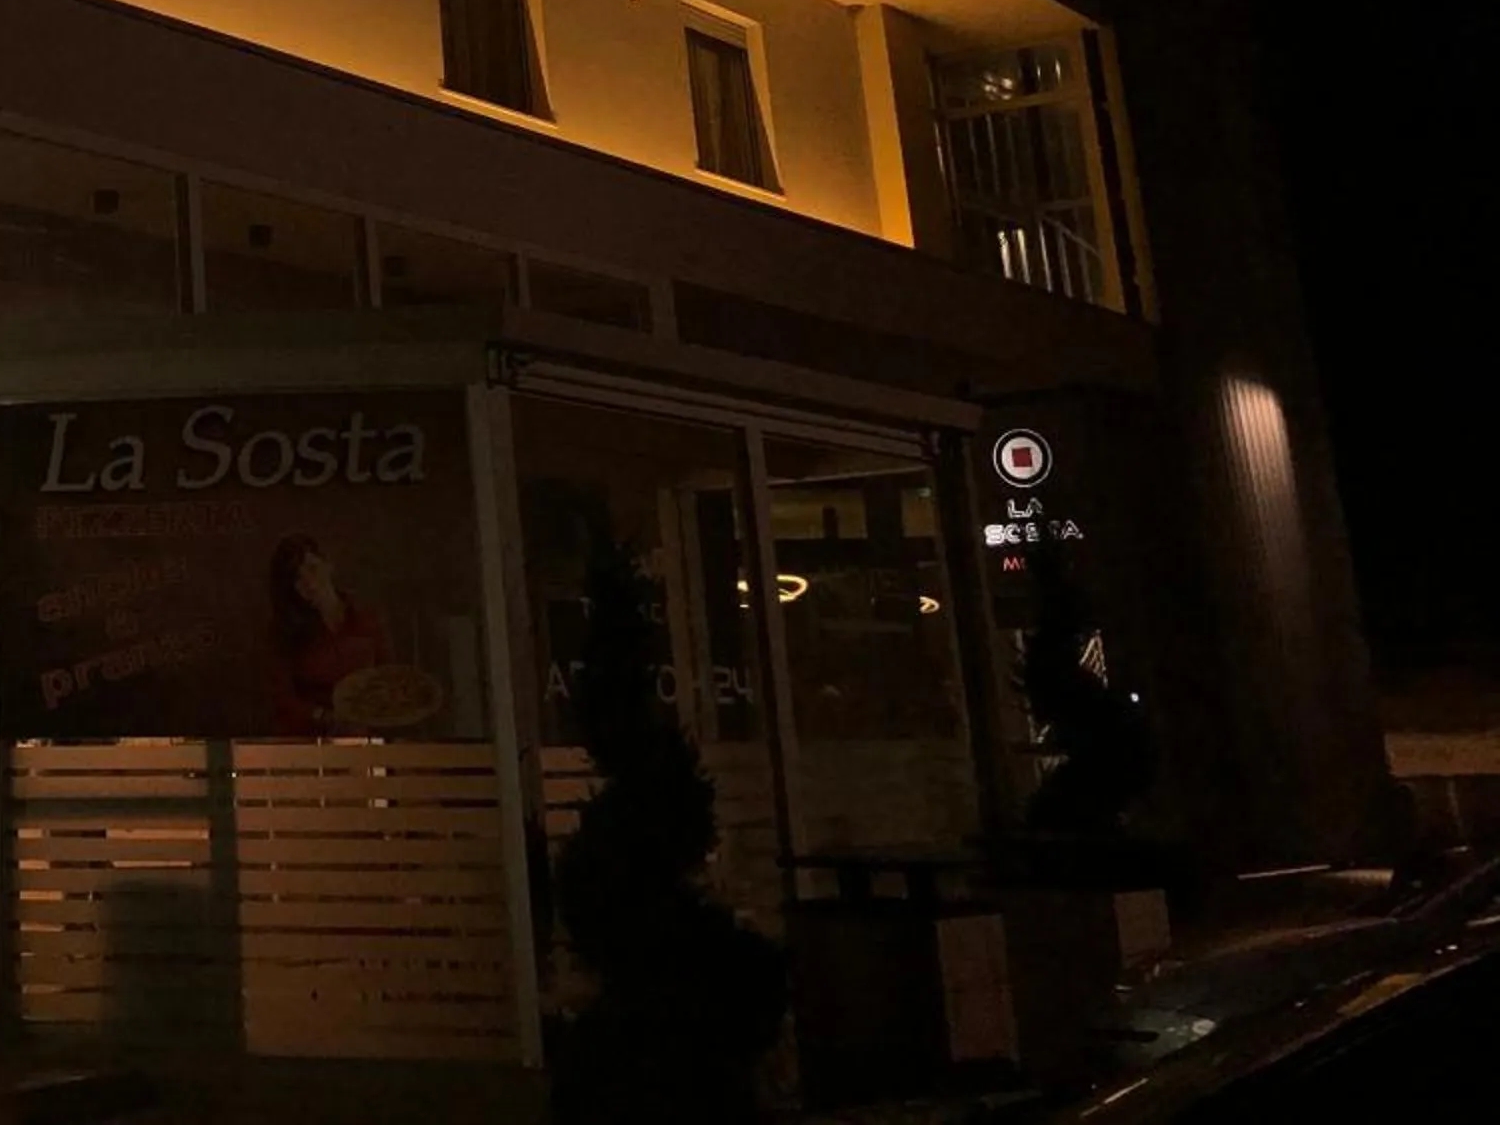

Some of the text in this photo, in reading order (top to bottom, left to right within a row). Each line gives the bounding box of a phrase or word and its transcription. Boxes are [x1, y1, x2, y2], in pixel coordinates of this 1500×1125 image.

[39, 404, 430, 493] La Sosta
[1005, 496, 1044, 519] LA
